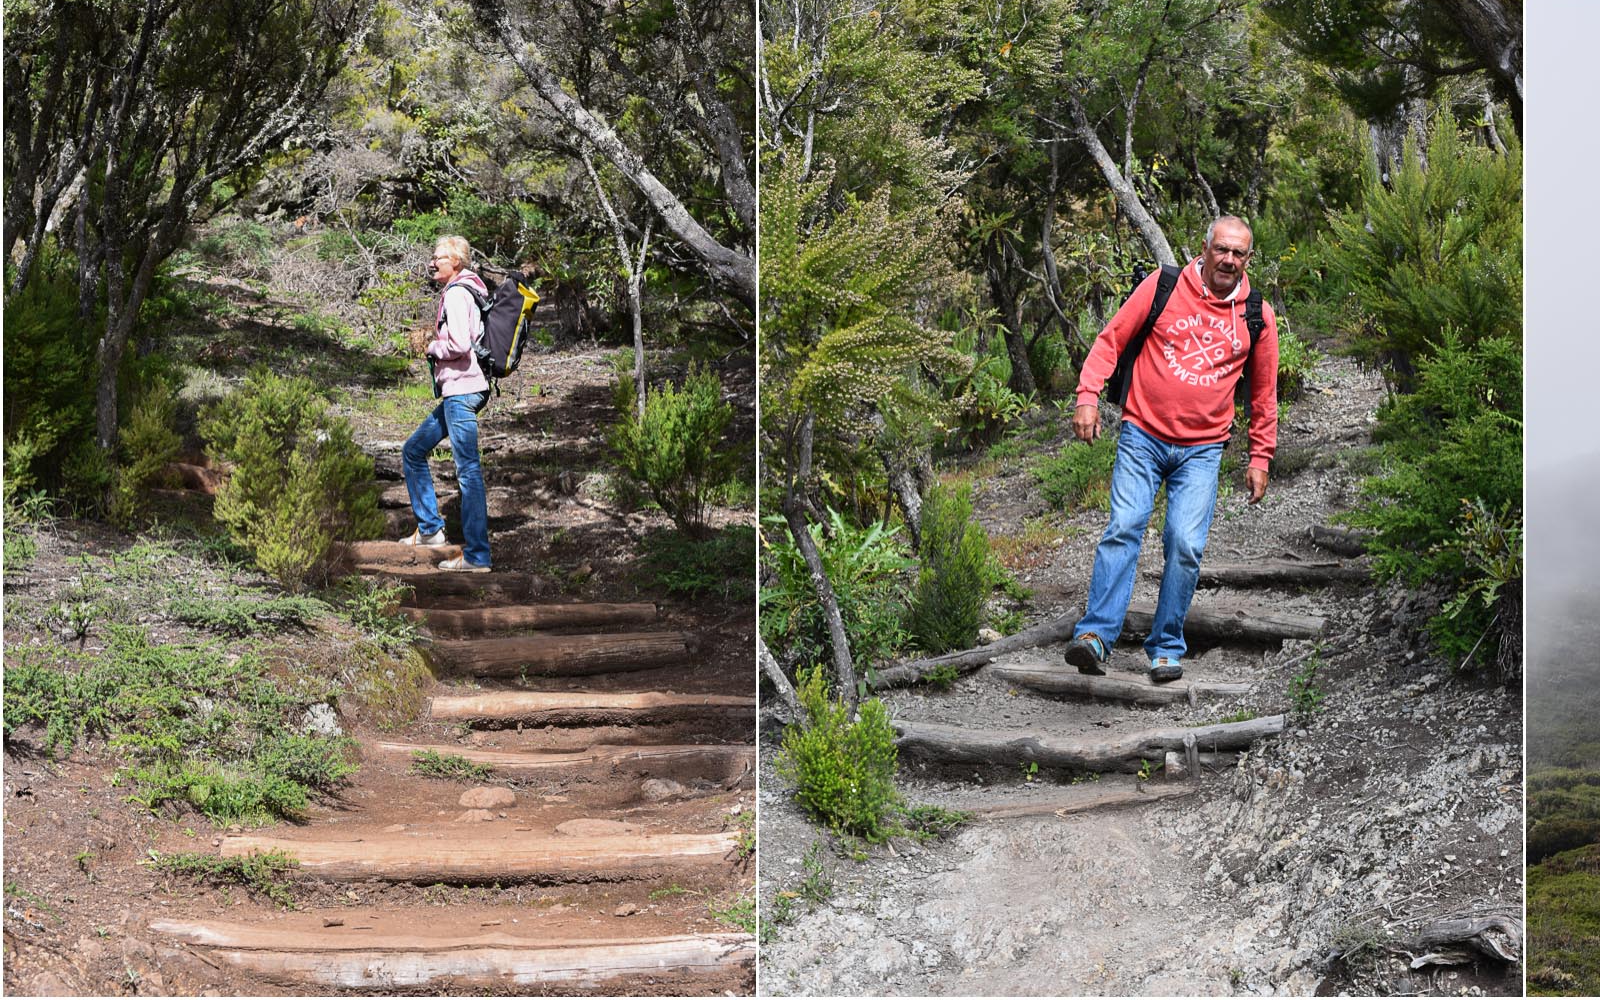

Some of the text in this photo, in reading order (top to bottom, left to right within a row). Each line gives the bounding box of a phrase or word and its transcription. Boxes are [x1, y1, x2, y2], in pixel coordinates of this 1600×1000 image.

[1166, 314, 1203, 336] TOM
[1183, 331, 1213, 351] 1 6
[1192, 348, 1225, 370] 2 9
